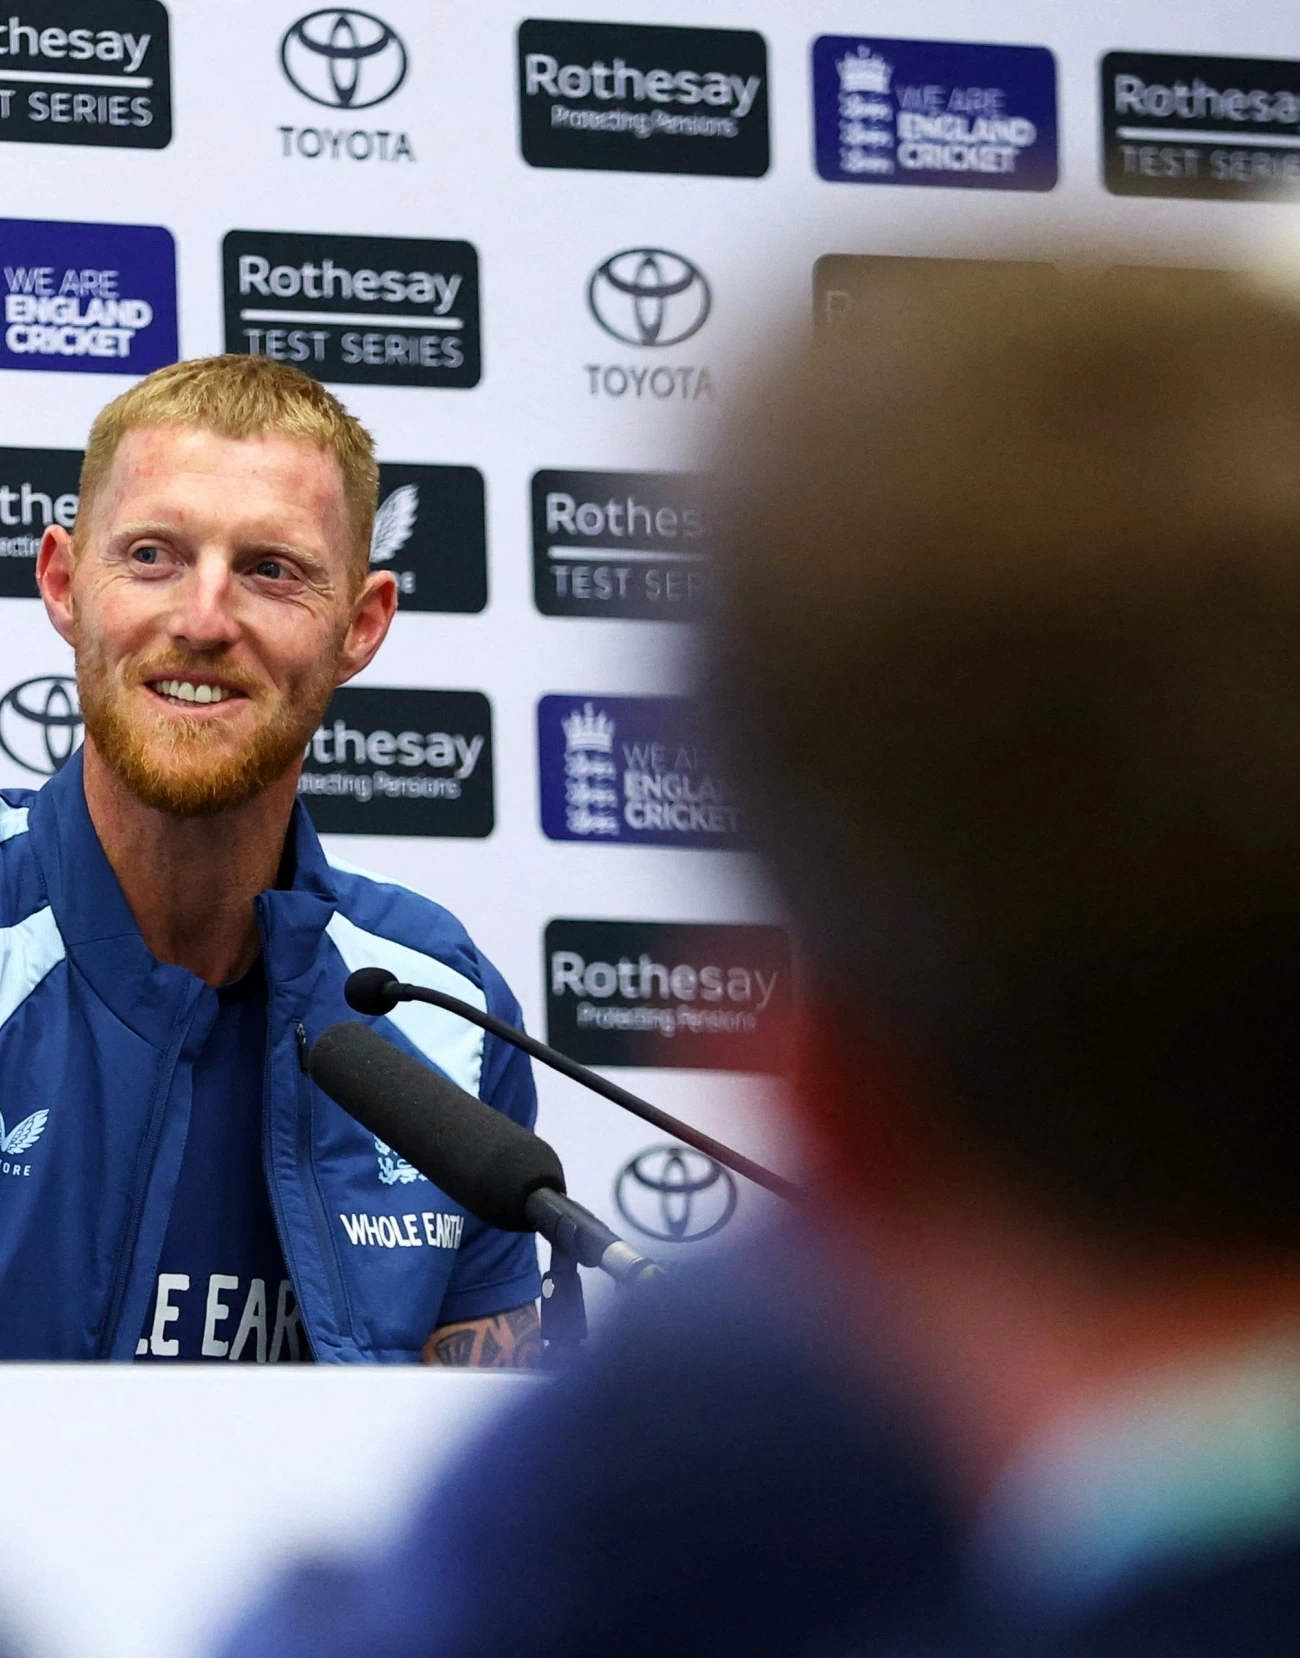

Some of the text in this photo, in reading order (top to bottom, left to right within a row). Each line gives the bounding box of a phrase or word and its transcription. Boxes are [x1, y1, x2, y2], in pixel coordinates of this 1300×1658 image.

[525, 53, 761, 118] Rothesay
[1114, 74, 1300, 123] Rothesa
[28, 91, 153, 127] SERIES
[277, 126, 417, 163] TOYOTA
[896, 111, 1037, 147] ENGLAND
[1120, 144, 1199, 178] TEST
[3, 266, 120, 300] WE ARE
[238, 254, 463, 315] Rothesay
[5, 294, 153, 329] ENGLAND
[5, 323, 136, 358] CRICKET
[243, 327, 464, 368] TEST SERIES
[551, 565, 632, 600] TEST
[304, 719, 485, 779] thesay
[552, 951, 778, 1009] Rothesay
[340, 1213, 422, 1249] WHOLE
